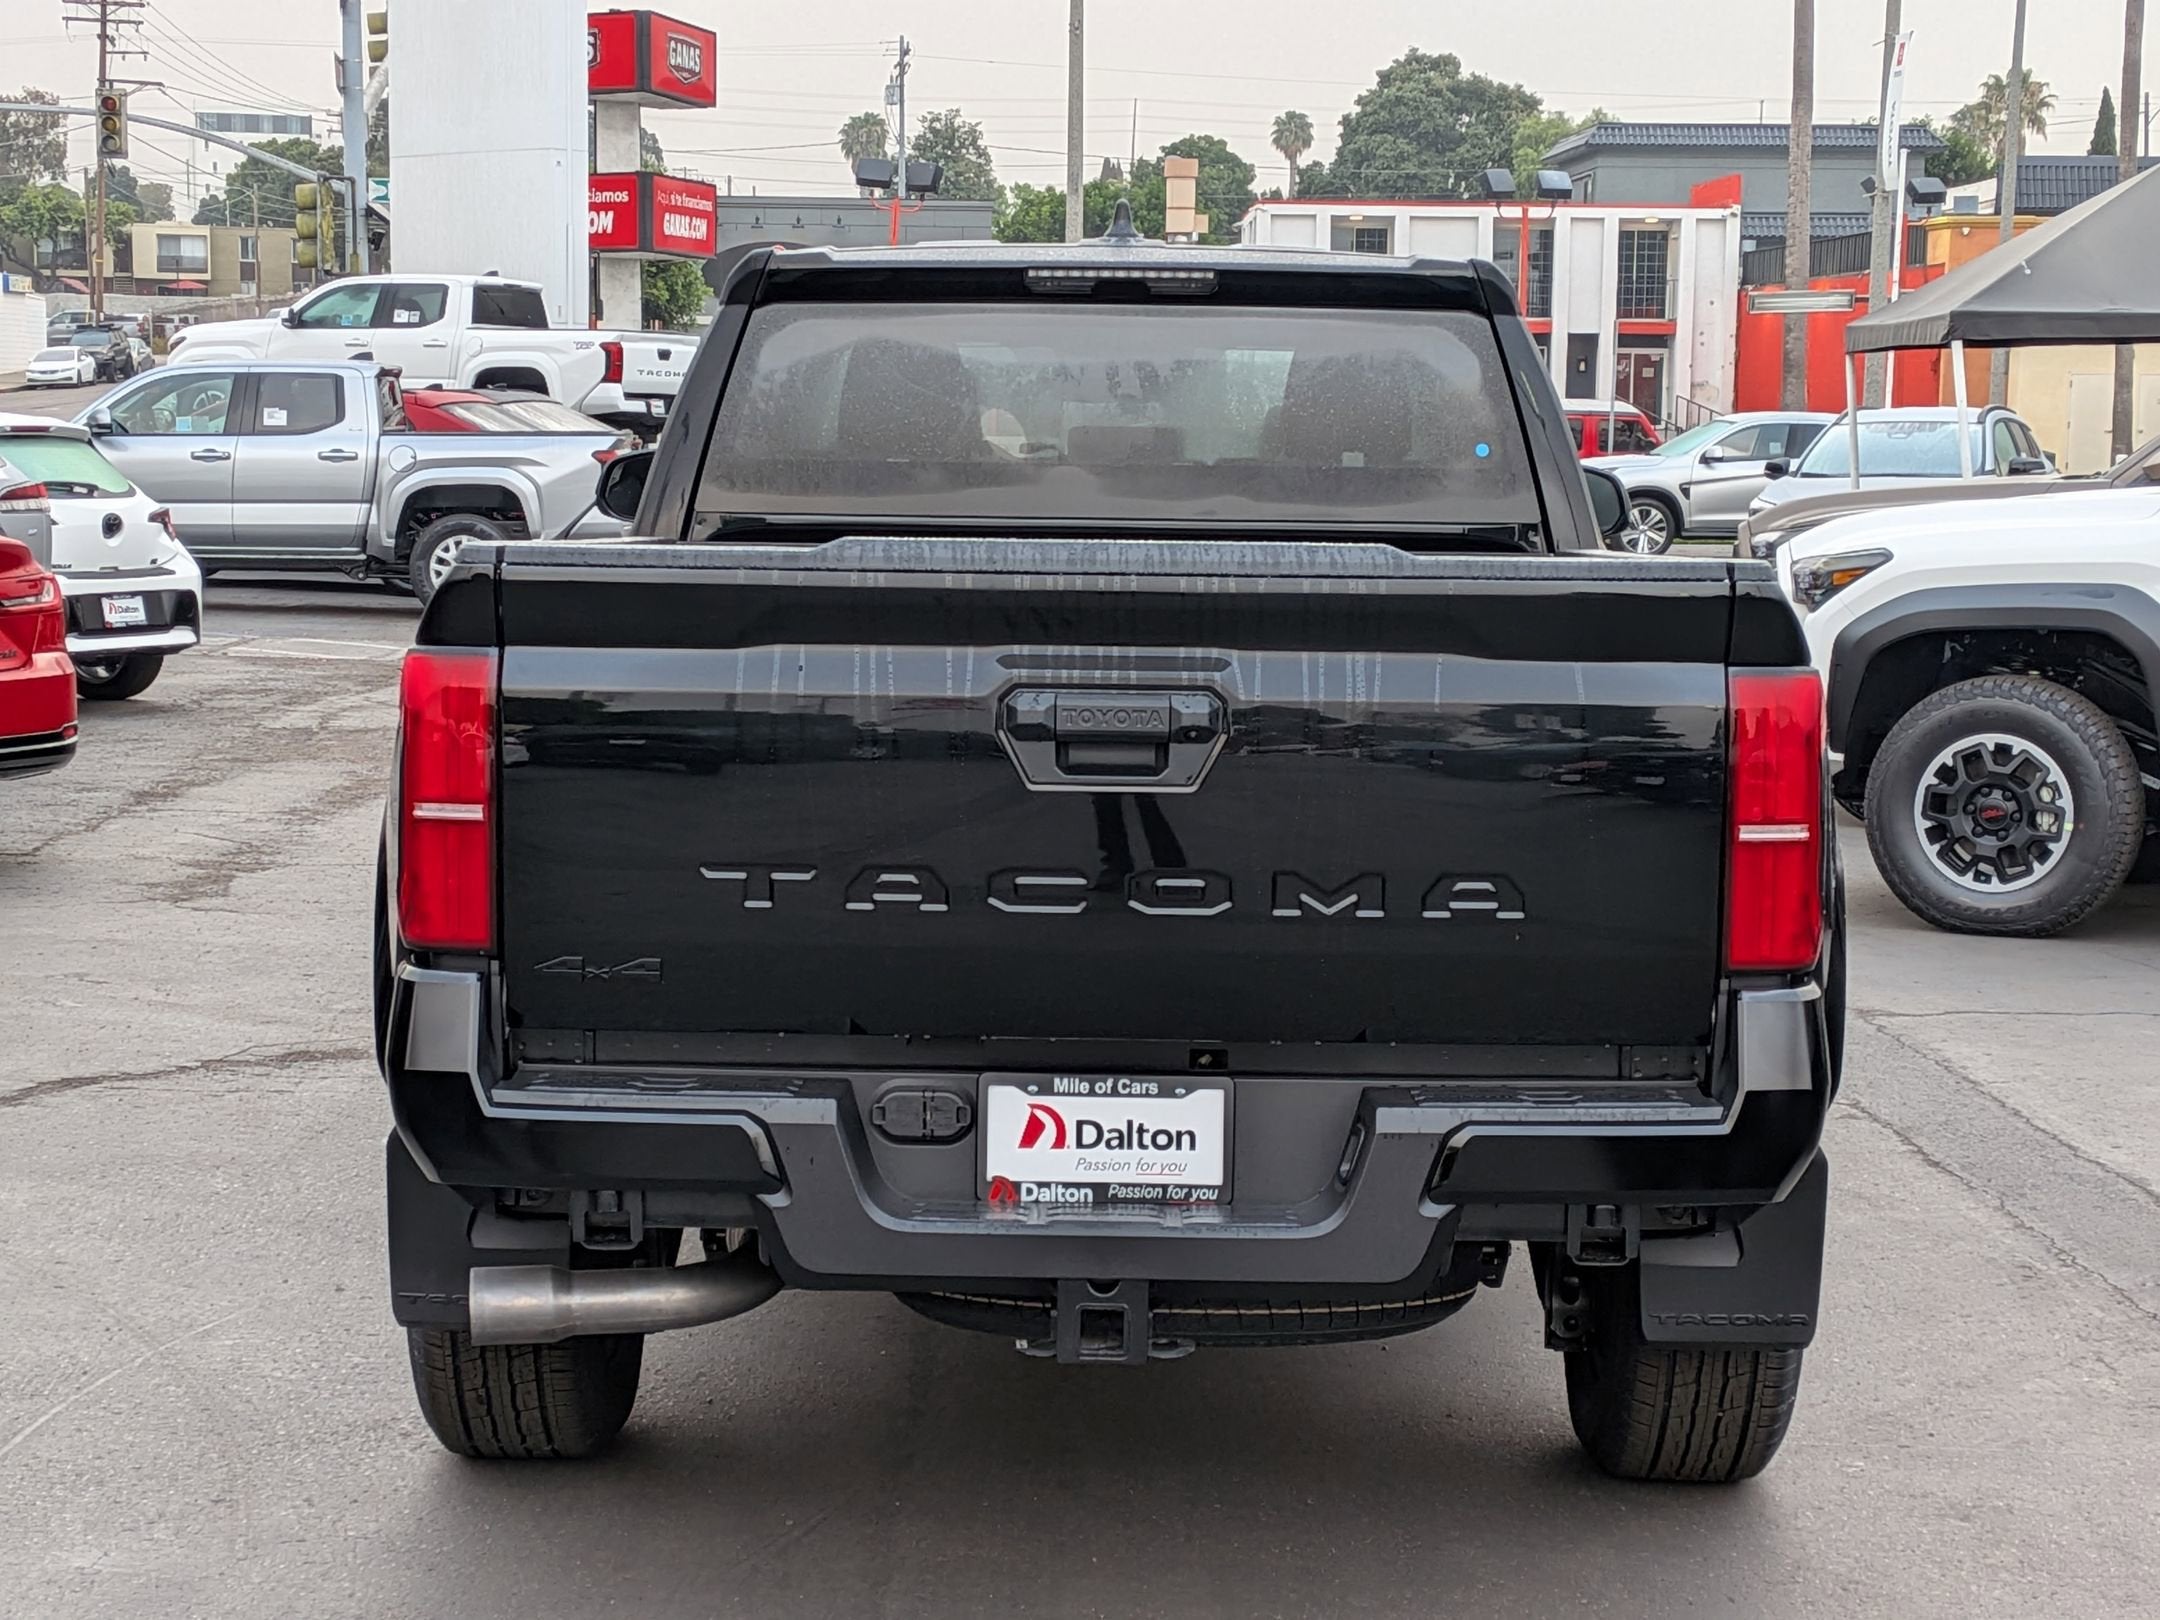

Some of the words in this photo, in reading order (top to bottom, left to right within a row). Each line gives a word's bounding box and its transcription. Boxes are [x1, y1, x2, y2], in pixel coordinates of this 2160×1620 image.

[669, 39, 701, 73] GANAS
[663, 212, 708, 240] GANAS.COM
[1061, 708, 1165, 729] TOYOTA
[700, 862, 1526, 919] TACOMA
[1053, 1078, 1090, 1094] Mile
[1094, 1078, 1112, 1095] of
[1117, 1078, 1159, 1096] Cars
[1075, 1119, 1196, 1152] Dalton
[1074, 1157, 1131, 1172] Passion
[1135, 1158, 1157, 1174] for
[1160, 1161, 1188, 1175] you
[1020, 1182, 1093, 1203] Dalton
[1107, 1184, 1162, 1200] Passion
[1165, 1184, 1189, 1202] for
[1190, 1187, 1219, 1204] you
[1649, 1313, 1809, 1327] TACOMA
